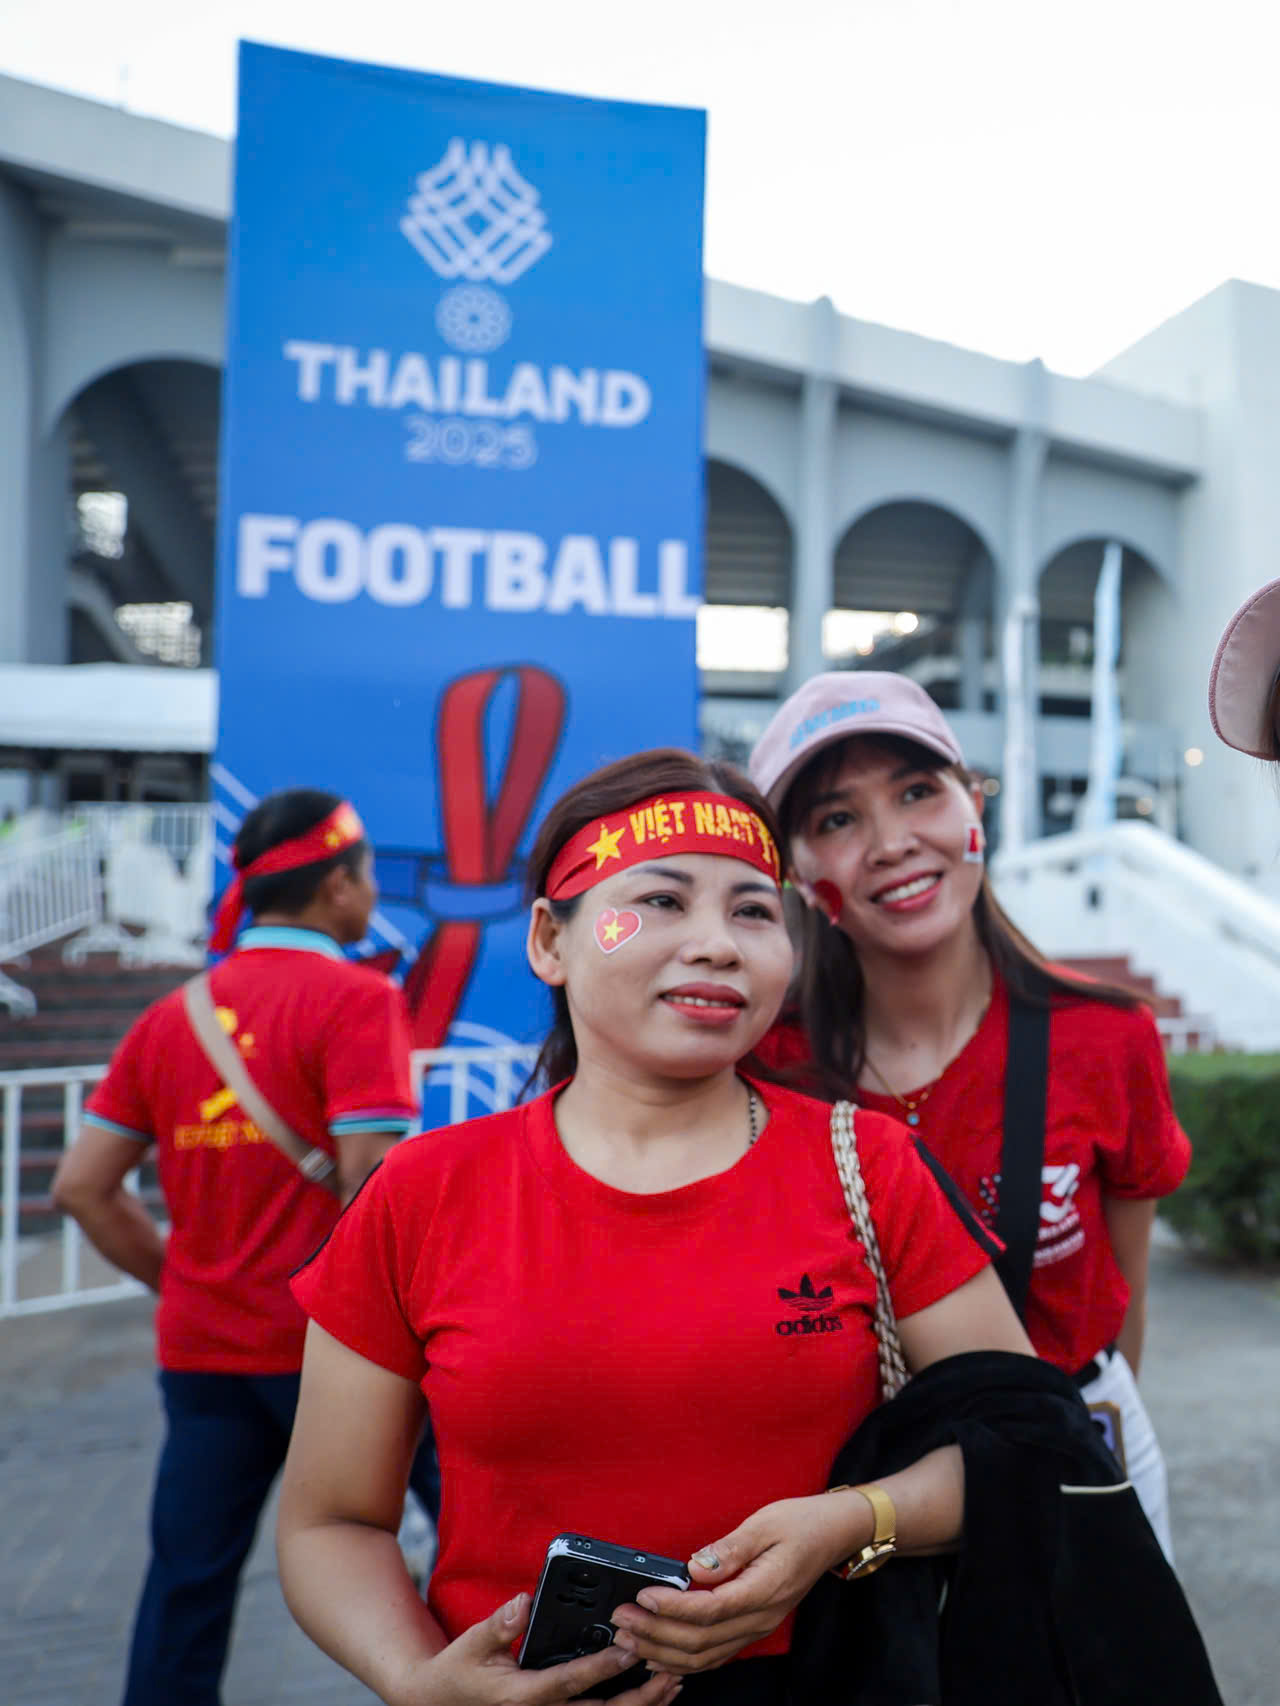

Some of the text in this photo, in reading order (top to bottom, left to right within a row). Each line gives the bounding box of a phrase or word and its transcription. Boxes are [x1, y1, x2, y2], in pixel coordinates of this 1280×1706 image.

[284, 340, 651, 428] THAILAND
[405, 415, 538, 470] 2025
[237, 512, 701, 619] FOOTBALL
[776, 1313, 843, 1336] adidas
